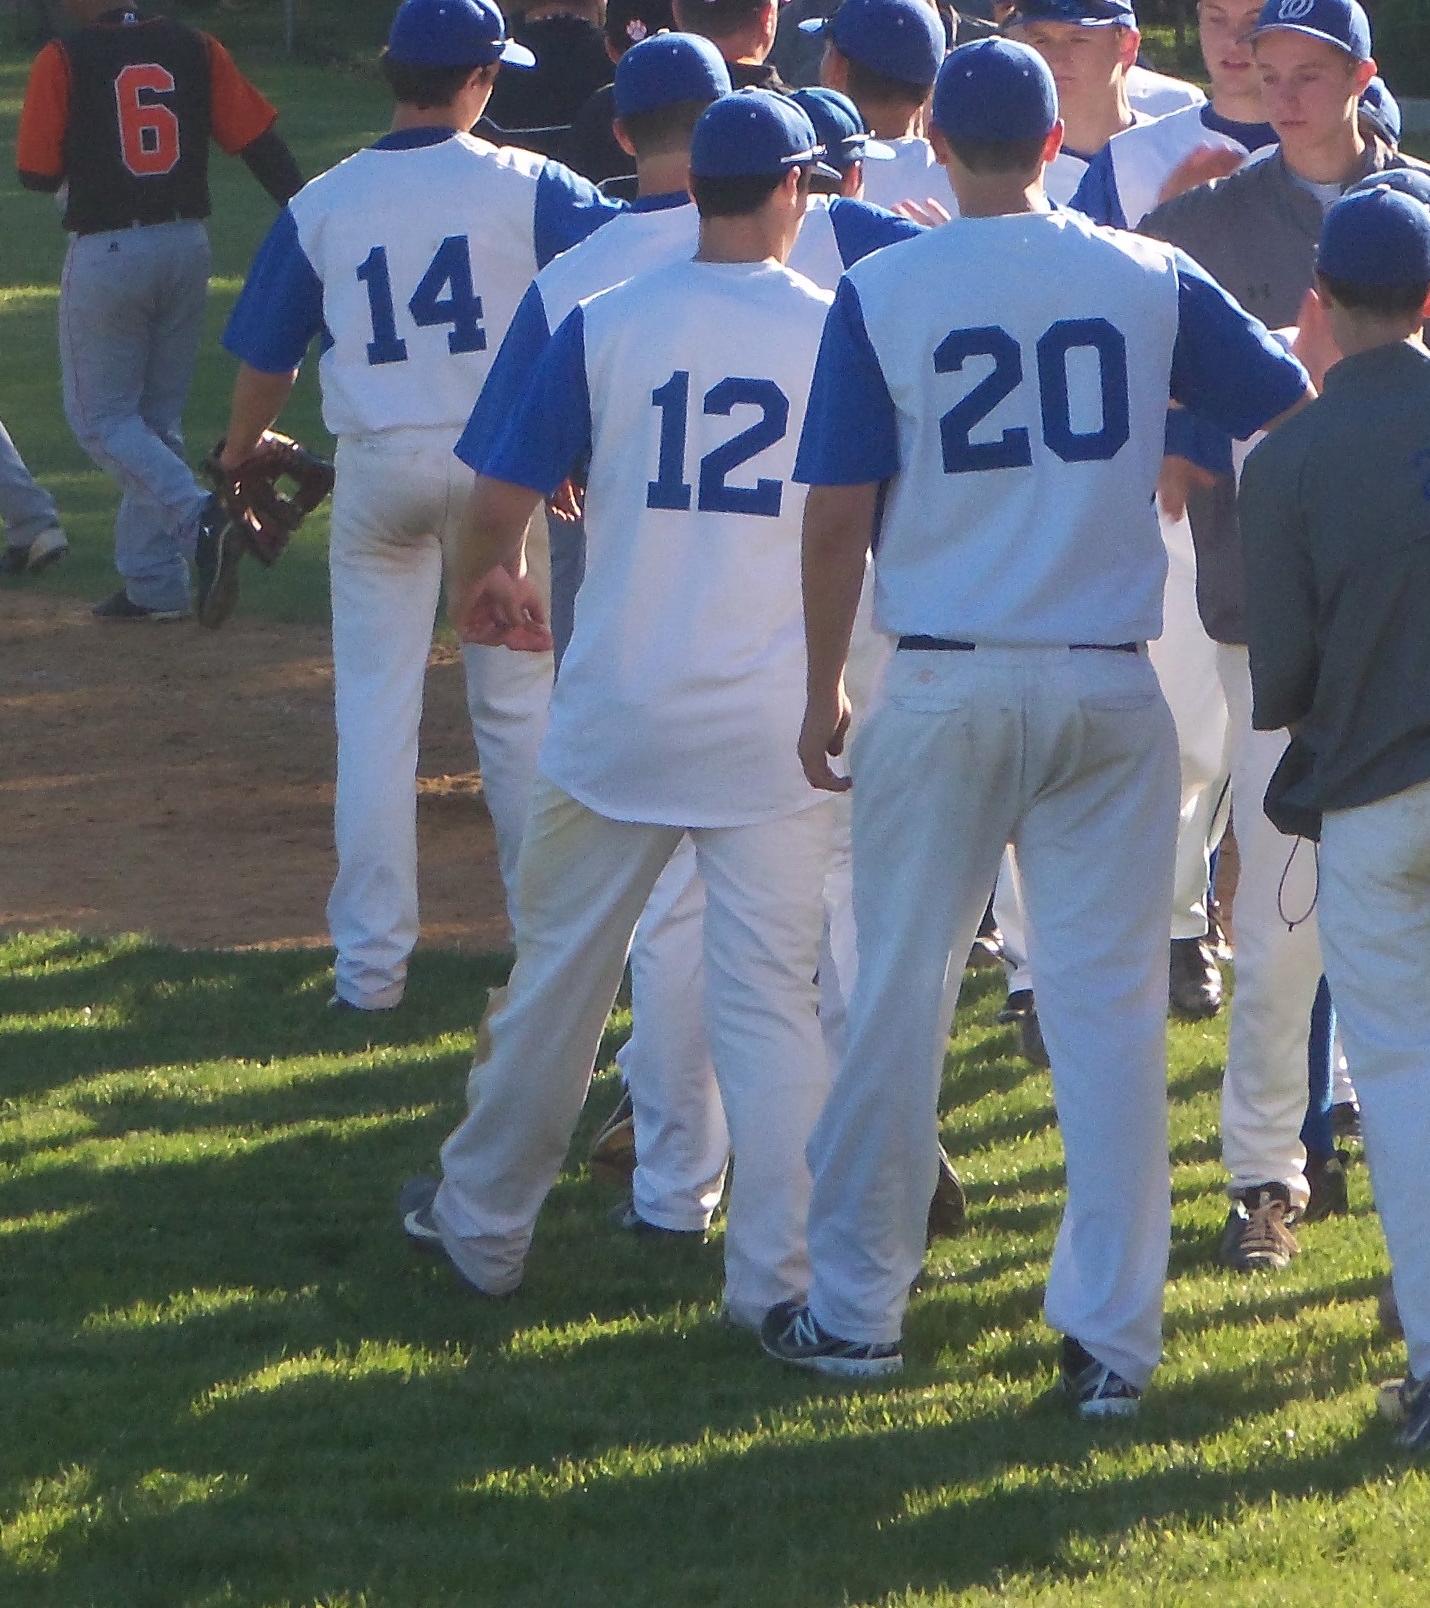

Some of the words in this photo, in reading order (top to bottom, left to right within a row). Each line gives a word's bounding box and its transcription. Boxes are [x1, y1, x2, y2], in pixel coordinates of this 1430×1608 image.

[114, 63, 181, 177] 6
[356, 234, 488, 367] 14
[647, 371, 791, 519] 12
[932, 317, 1132, 475] 20
